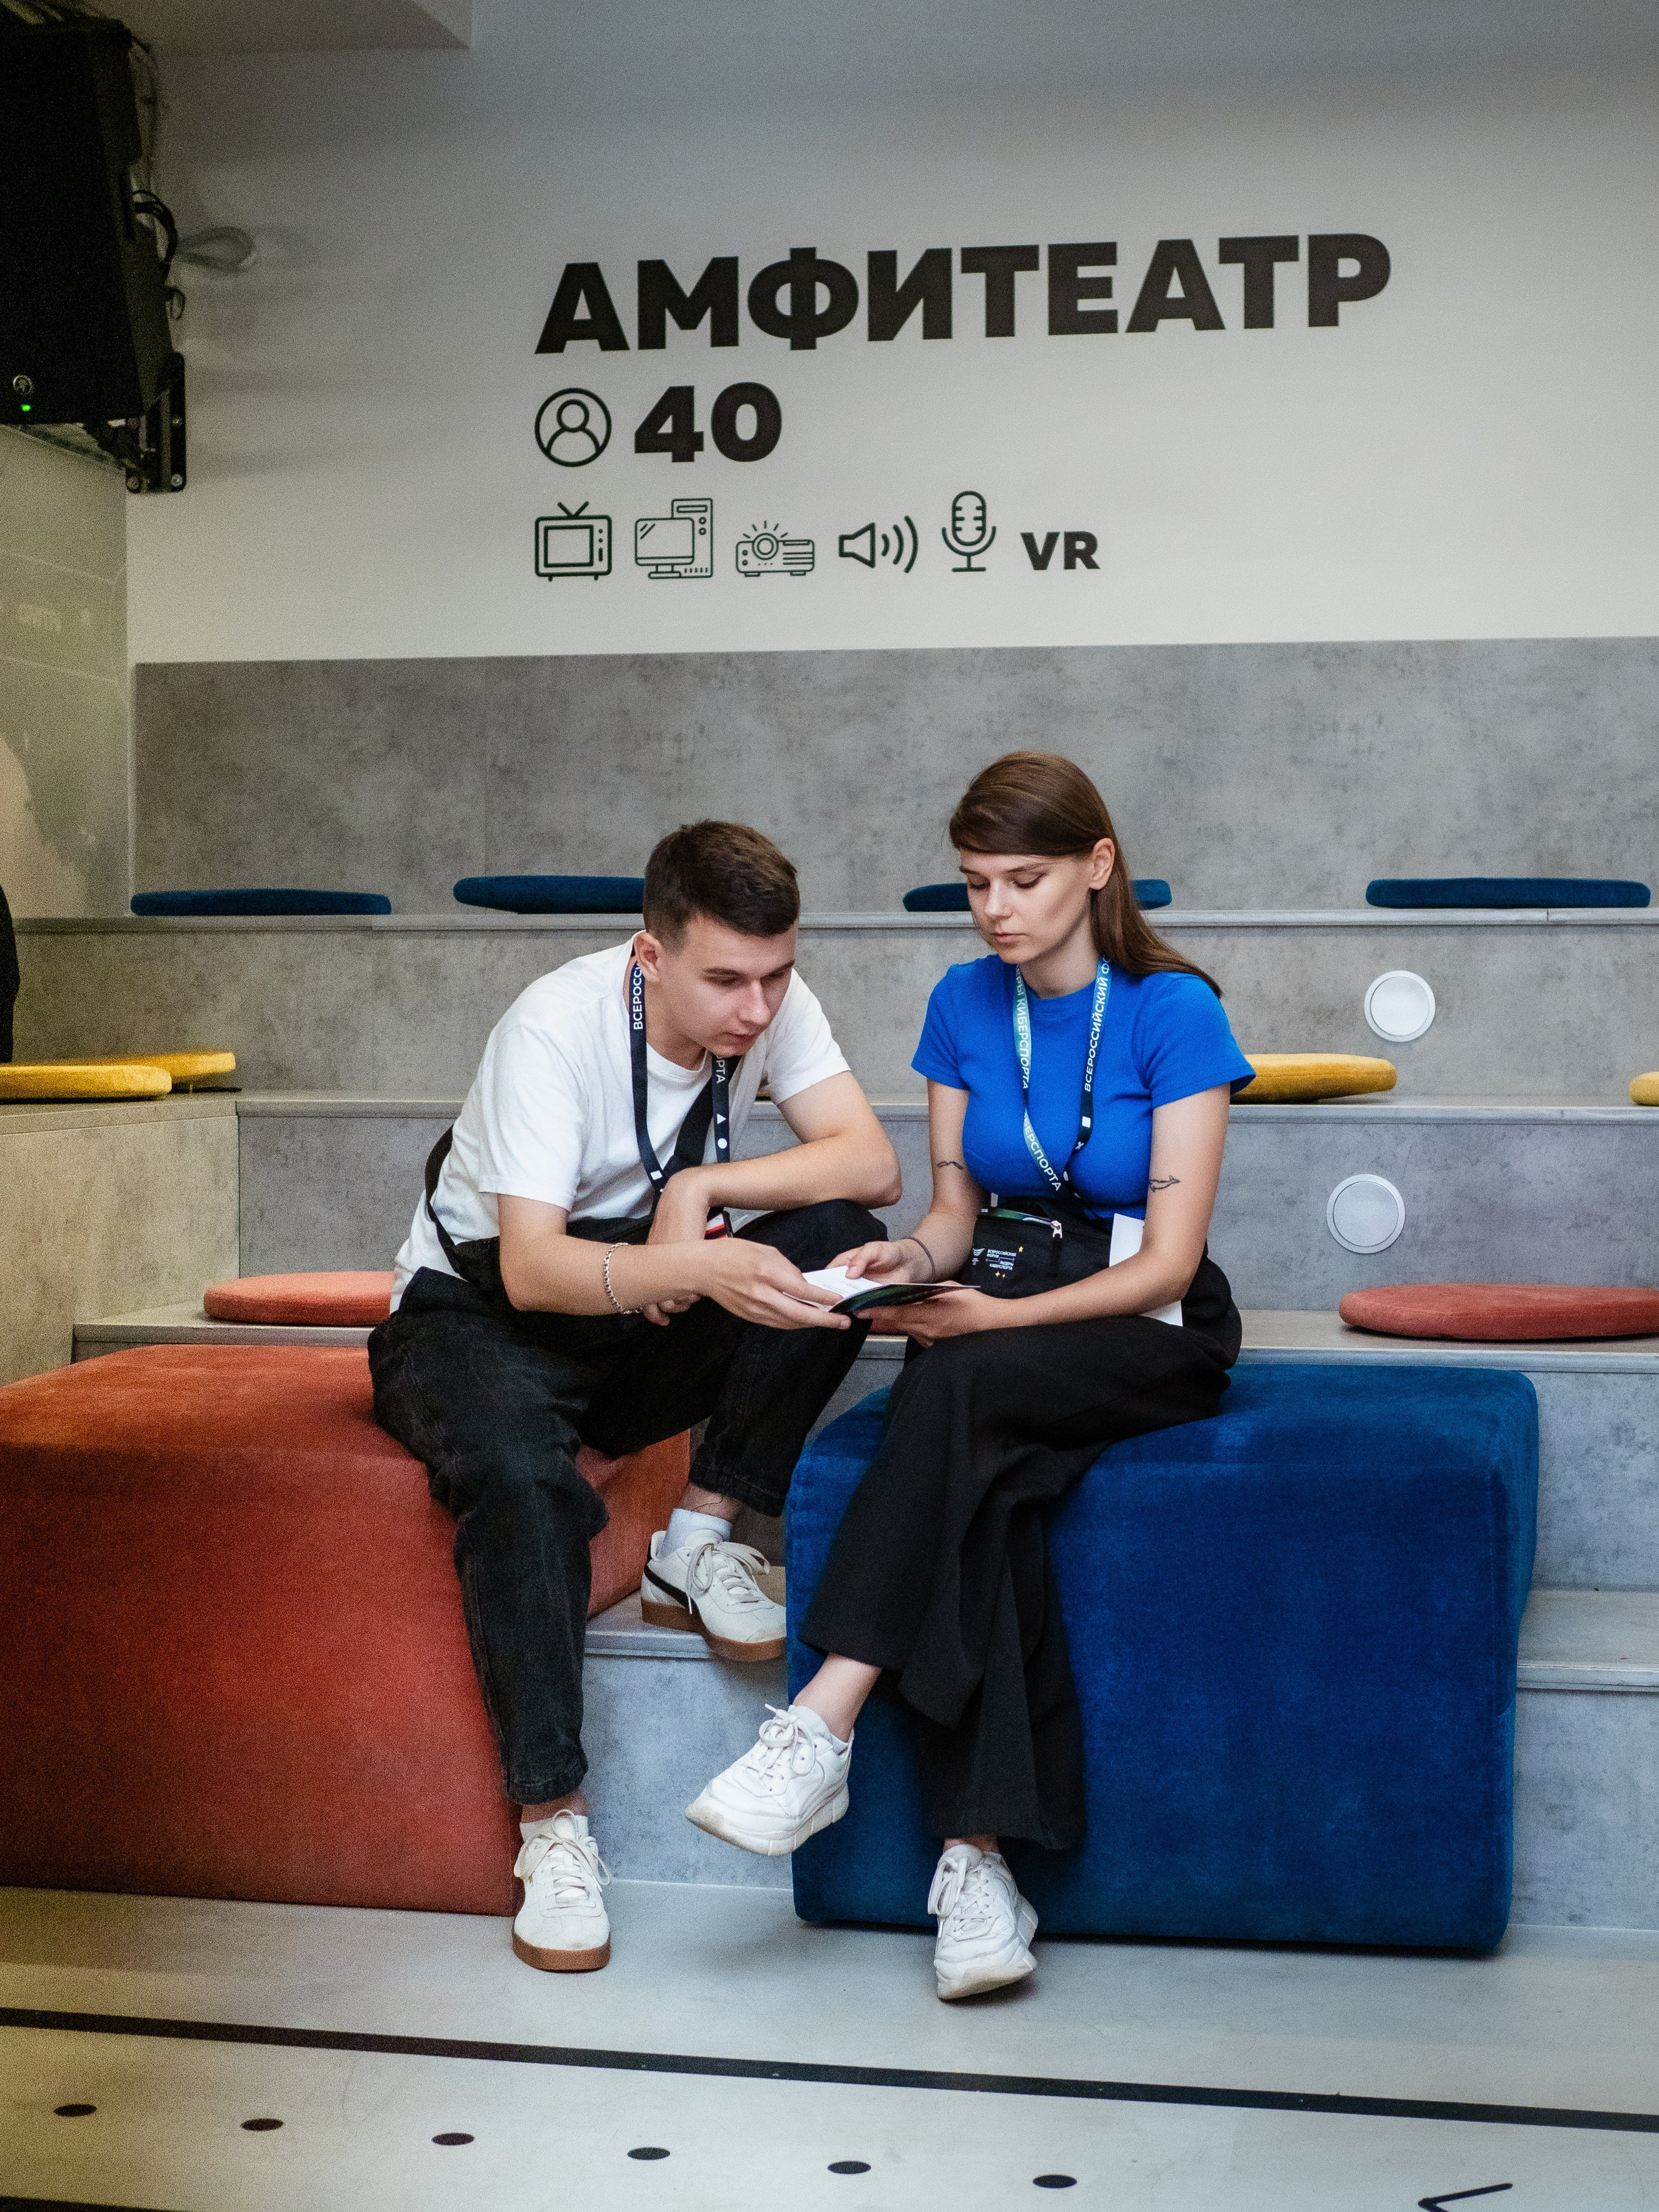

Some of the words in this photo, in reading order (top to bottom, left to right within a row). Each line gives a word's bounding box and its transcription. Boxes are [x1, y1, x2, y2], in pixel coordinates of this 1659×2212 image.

[534, 233, 1391, 355] АМФИТЕАТР
[633, 381, 783, 464] 40
[1021, 531, 1100, 571] VR
[1016, 999, 1030, 1089] КИБЕРСПОРТА
[1084, 976, 1108, 1092] ВСЕРОССИЙСКИЙ
